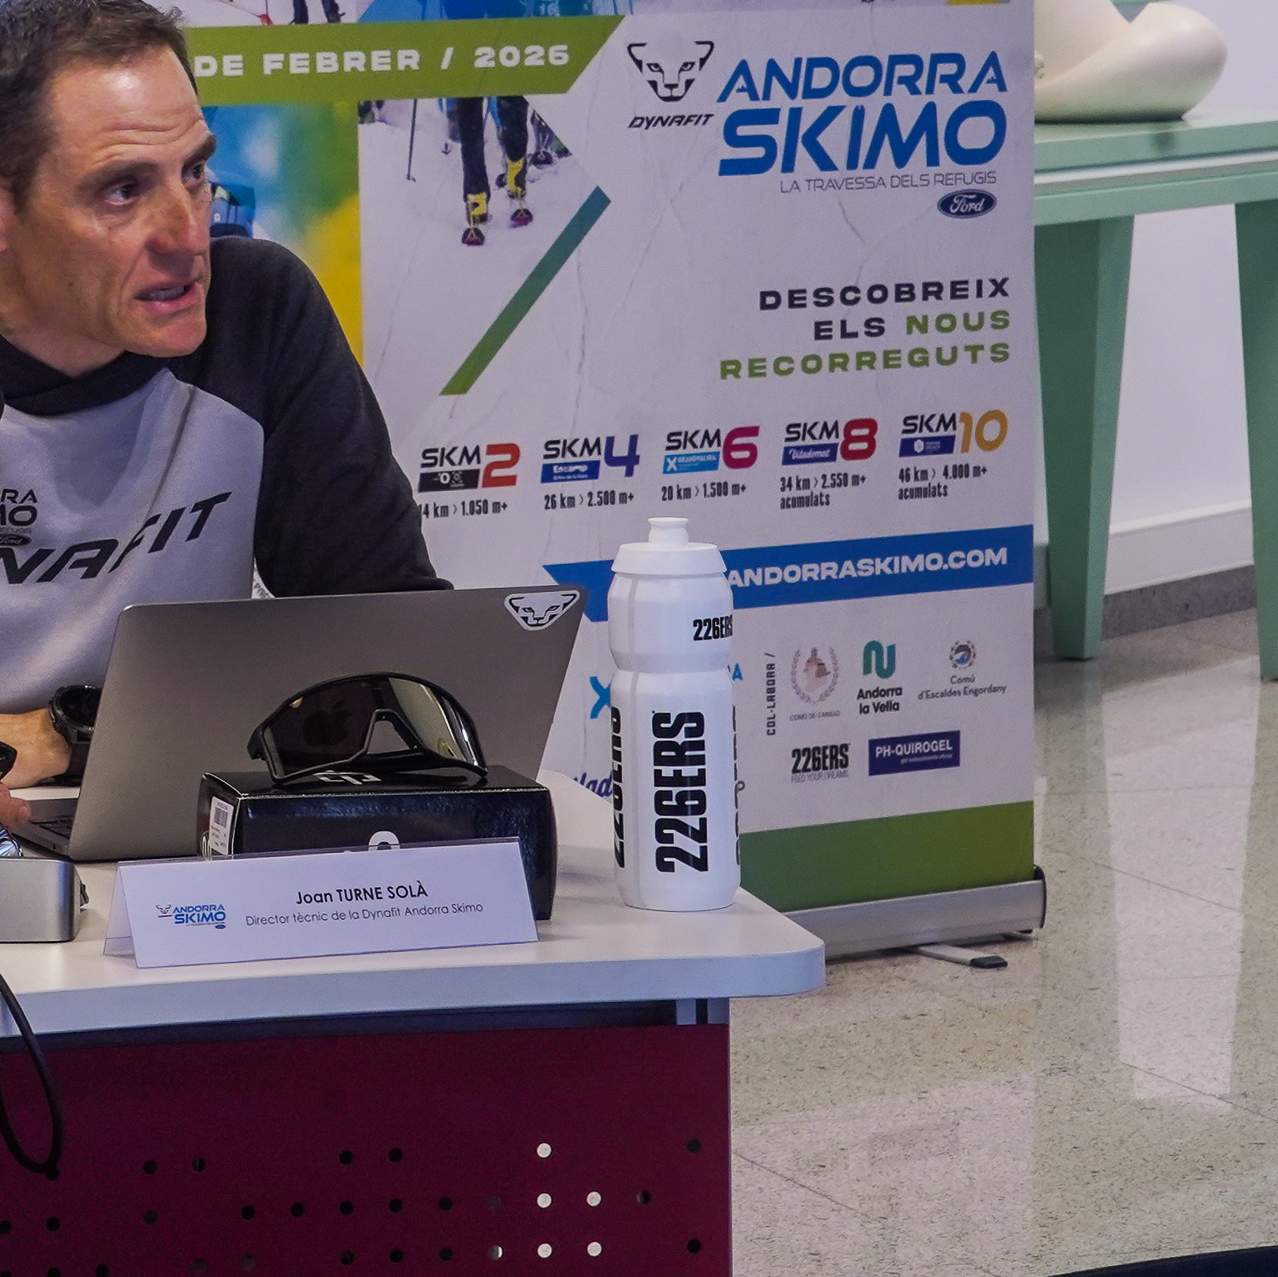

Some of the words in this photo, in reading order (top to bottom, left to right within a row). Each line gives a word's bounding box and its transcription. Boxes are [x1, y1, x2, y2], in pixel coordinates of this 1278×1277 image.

[191, 55, 243, 81] DE
[263, 49, 419, 74] FEBRER
[474, 45, 569, 68] 2026
[717, 50, 1008, 104] ANDORRA
[628, 114, 714, 130] DYNAFIT
[717, 99, 1008, 177] SKIMO
[805, 176, 886, 191] TRAVESSA
[891, 174, 930, 188] DELS
[934, 171, 996, 186] REFUGIS
[948, 194, 986, 215] Ford
[760, 277, 1009, 310] DESCOBREIX
[814, 317, 885, 340] ELS
[906, 310, 1010, 335] NOUS
[720, 342, 1009, 380] RECORREGUTS
[785, 420, 839, 442] SKM
[840, 418, 878, 461] 8
[902, 413, 956, 434] SKM
[959, 410, 1008, 453] 10
[543, 437, 601, 459] SKM
[604, 434, 640, 477] 4
[665, 429, 721, 451] SKM
[722, 426, 759, 469] 6
[421, 445, 480, 468] SKM
[482, 443, 520, 488] 2
[780, 491, 830, 509] acumulats
[898, 483, 948, 500] acumulats
[726, 547, 1008, 587] ANDORRASKIMO.COM
[857, 687, 902, 700] Andorra
[950, 674, 975, 684] Comú
[963, 684, 1006, 697] Engordany
[872, 700, 899, 713] Vella
[791, 744, 849, 774] 226ERS
[875, 740, 953, 758] PH-QUIROGEL
[652, 711, 708, 872] 226ERS
[297, 892, 333, 904] Joan
[336, 887, 383, 901] TURNE
[387, 881, 428, 899] SOLÀ
[246, 915, 289, 926] Director
[293, 912, 328, 923] tècnic
[362, 907, 400, 920] Dynafit
[404, 903, 448, 917] Andorra
[451, 900, 483, 914] Skimo
